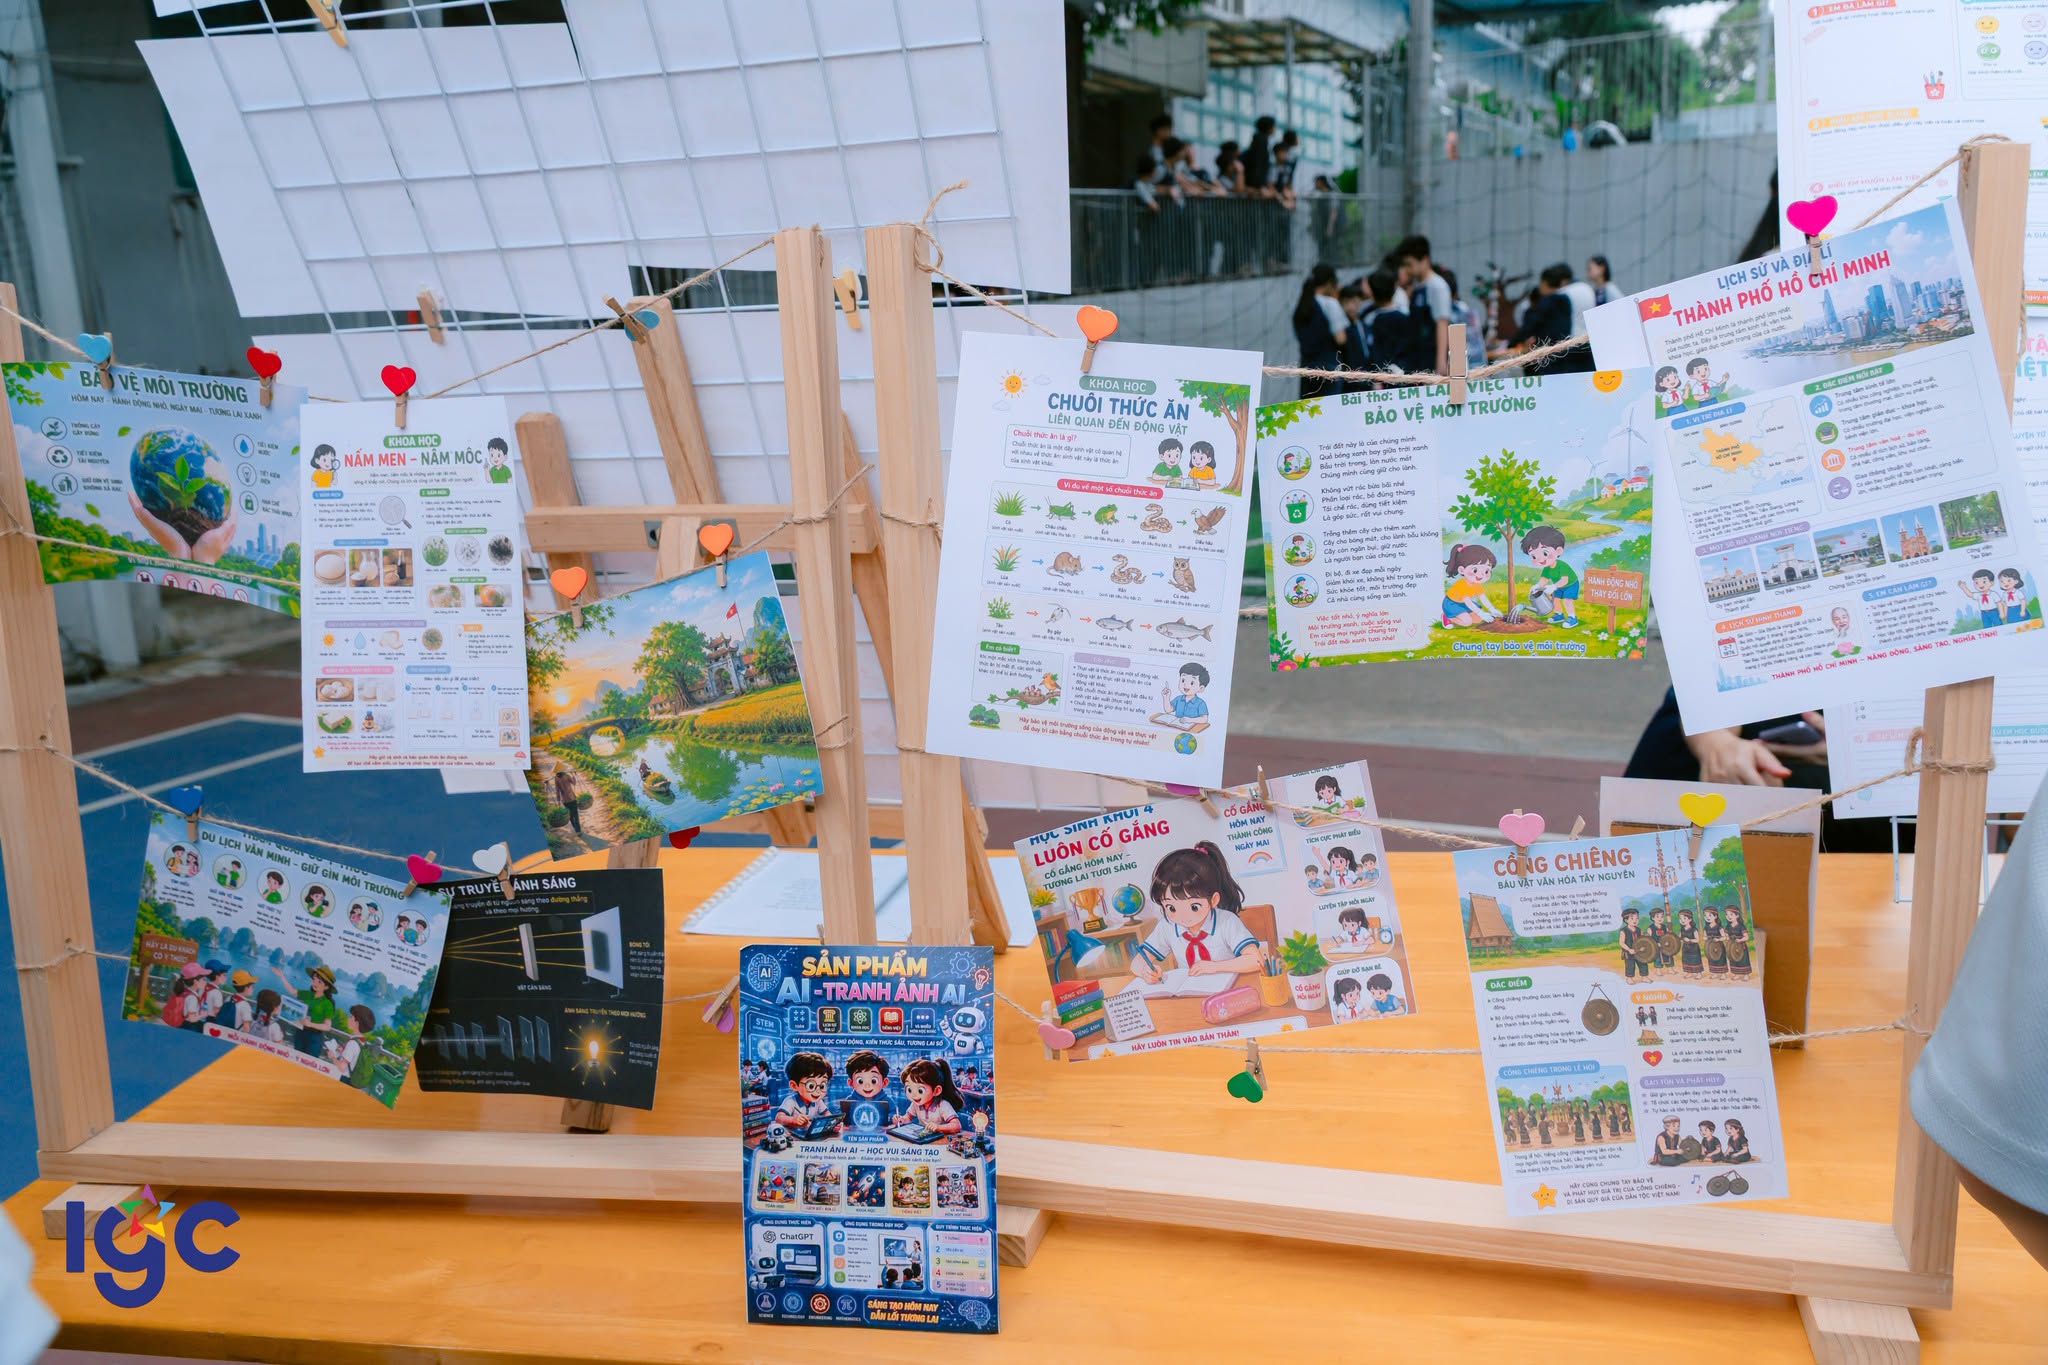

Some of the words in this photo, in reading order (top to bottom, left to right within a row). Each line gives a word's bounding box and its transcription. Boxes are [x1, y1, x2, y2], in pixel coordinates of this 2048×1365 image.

[1717, 270, 1747, 290] LỊCH
[1751, 262, 1768, 280] SỬ
[1771, 256, 1790, 273] VÀ
[1673, 296, 1733, 326] THÀNH
[1738, 279, 1773, 309] PHỐ
[1778, 271, 1803, 298] HỒ
[1809, 262, 1838, 288] CHÍ
[1843, 250, 1890, 279] MINH
[118, 372, 141, 395] VỆ
[143, 375, 176, 396] MÔI
[178, 380, 248, 403] TRƯỜNG
[1089, 379, 1119, 390] KHOA
[1123, 382, 1146, 392] HỌC
[1341, 393, 1361, 406] Bài
[1367, 391, 1392, 403] thơ:
[1109, 396, 1157, 418] THỨC
[1164, 398, 1189, 420] ĂN
[1364, 406, 1397, 425] BẢO
[1404, 403, 1424, 424] VỆ
[1468, 395, 1536, 415] TRƯỜNG
[1048, 412, 1071, 425] LIÊN
[1075, 417, 1104, 428] QUAN
[1108, 418, 1130, 431] ĐẾN
[1134, 421, 1164, 434] ĐỘNG
[1169, 423, 1188, 437] VẬT
[388, 436, 416, 446] KHOA
[419, 436, 438, 447] HỌC
[1034, 430, 1048, 439] thức
[1060, 432, 1065, 441] là
[1068, 434, 1077, 442] gì?
[344, 448, 374, 467] NẤM
[379, 453, 406, 466] MEN
[1453, 641, 1482, 652] Chung
[1486, 641, 1500, 651] tay
[1504, 640, 1520, 650] bảo
[1524, 640, 1534, 652] vệ
[1536, 640, 1552, 650] môi
[1556, 640, 1586, 652] trường
[1224, 803, 1237, 817] CỐ
[1229, 819, 1248, 829] HÔM
[1250, 816, 1265, 825] NAY
[1227, 831, 1251, 840] THÀNH
[1253, 827, 1273, 836] CÔNG
[1034, 841, 1083, 867] LUÔN
[1088, 827, 1113, 851] CỐ
[1119, 820, 1170, 843] GẮNG
[1235, 841, 1253, 851] NGÀY
[1256, 839, 1269, 847] MAI
[201, 831, 216, 843] DU
[218, 835, 242, 850] LỊCH
[245, 843, 264, 858] VĂN
[266, 851, 291, 867] MINH
[301, 862, 320, 876] GIỮ
[321, 867, 339, 881] GÌN
[342, 874, 361, 887] MÔI
[1044, 867, 1056, 880] CỐ
[1058, 862, 1082, 875] GẮNG
[1084, 857, 1105, 870] HÔM
[1107, 852, 1124, 863] NAY
[1555, 846, 1632, 872] CHIÊNG
[513, 876, 539, 891] ÁNH
[542, 876, 576, 889] SÁNG
[1043, 878, 1073, 891] TƯƠNG
[1076, 873, 1089, 882] LAI
[1091, 868, 1112, 878] TƯƠI
[1114, 861, 1138, 873] SÁNG
[1498, 880, 1515, 889] BÁU
[1518, 879, 1534, 890] VẬT
[1536, 877, 1555, 886] VĂN
[1558, 876, 1577, 885] HÓA
[1579, 874, 1595, 882] TÂY
[1598, 870, 1635, 880] NGUYÊN
[802, 949, 850, 977] SẢN
[856, 949, 928, 978] PHẨM
[760, 967, 771, 978] AI
[776, 976, 810, 1004] AI
[894, 977, 939, 1002] ẢNH
[941, 984, 966, 1004] AI
[756, 1018, 775, 1028] STEM
[1131, 1043, 1145, 1051] HÃY
[1200, 1033, 1215, 1041] BẢN
[1216, 1030, 1239, 1038] THÂN!
[860, 1112, 873, 1123] AI
[830, 1145, 847, 1153] ẢNH
[901, 1148, 922, 1156] SÁNG
[925, 1149, 939, 1158] TẠO
[868, 1299, 888, 1309] SÁNG
[889, 1301, 903, 1311] TẠO
[904, 1301, 921, 1310] HÔM
[923, 1303, 939, 1311] NAY
[887, 1311, 899, 1321] LỐI
[900, 1313, 925, 1322] TƯƠNG
[927, 1315, 939, 1323] LAI
